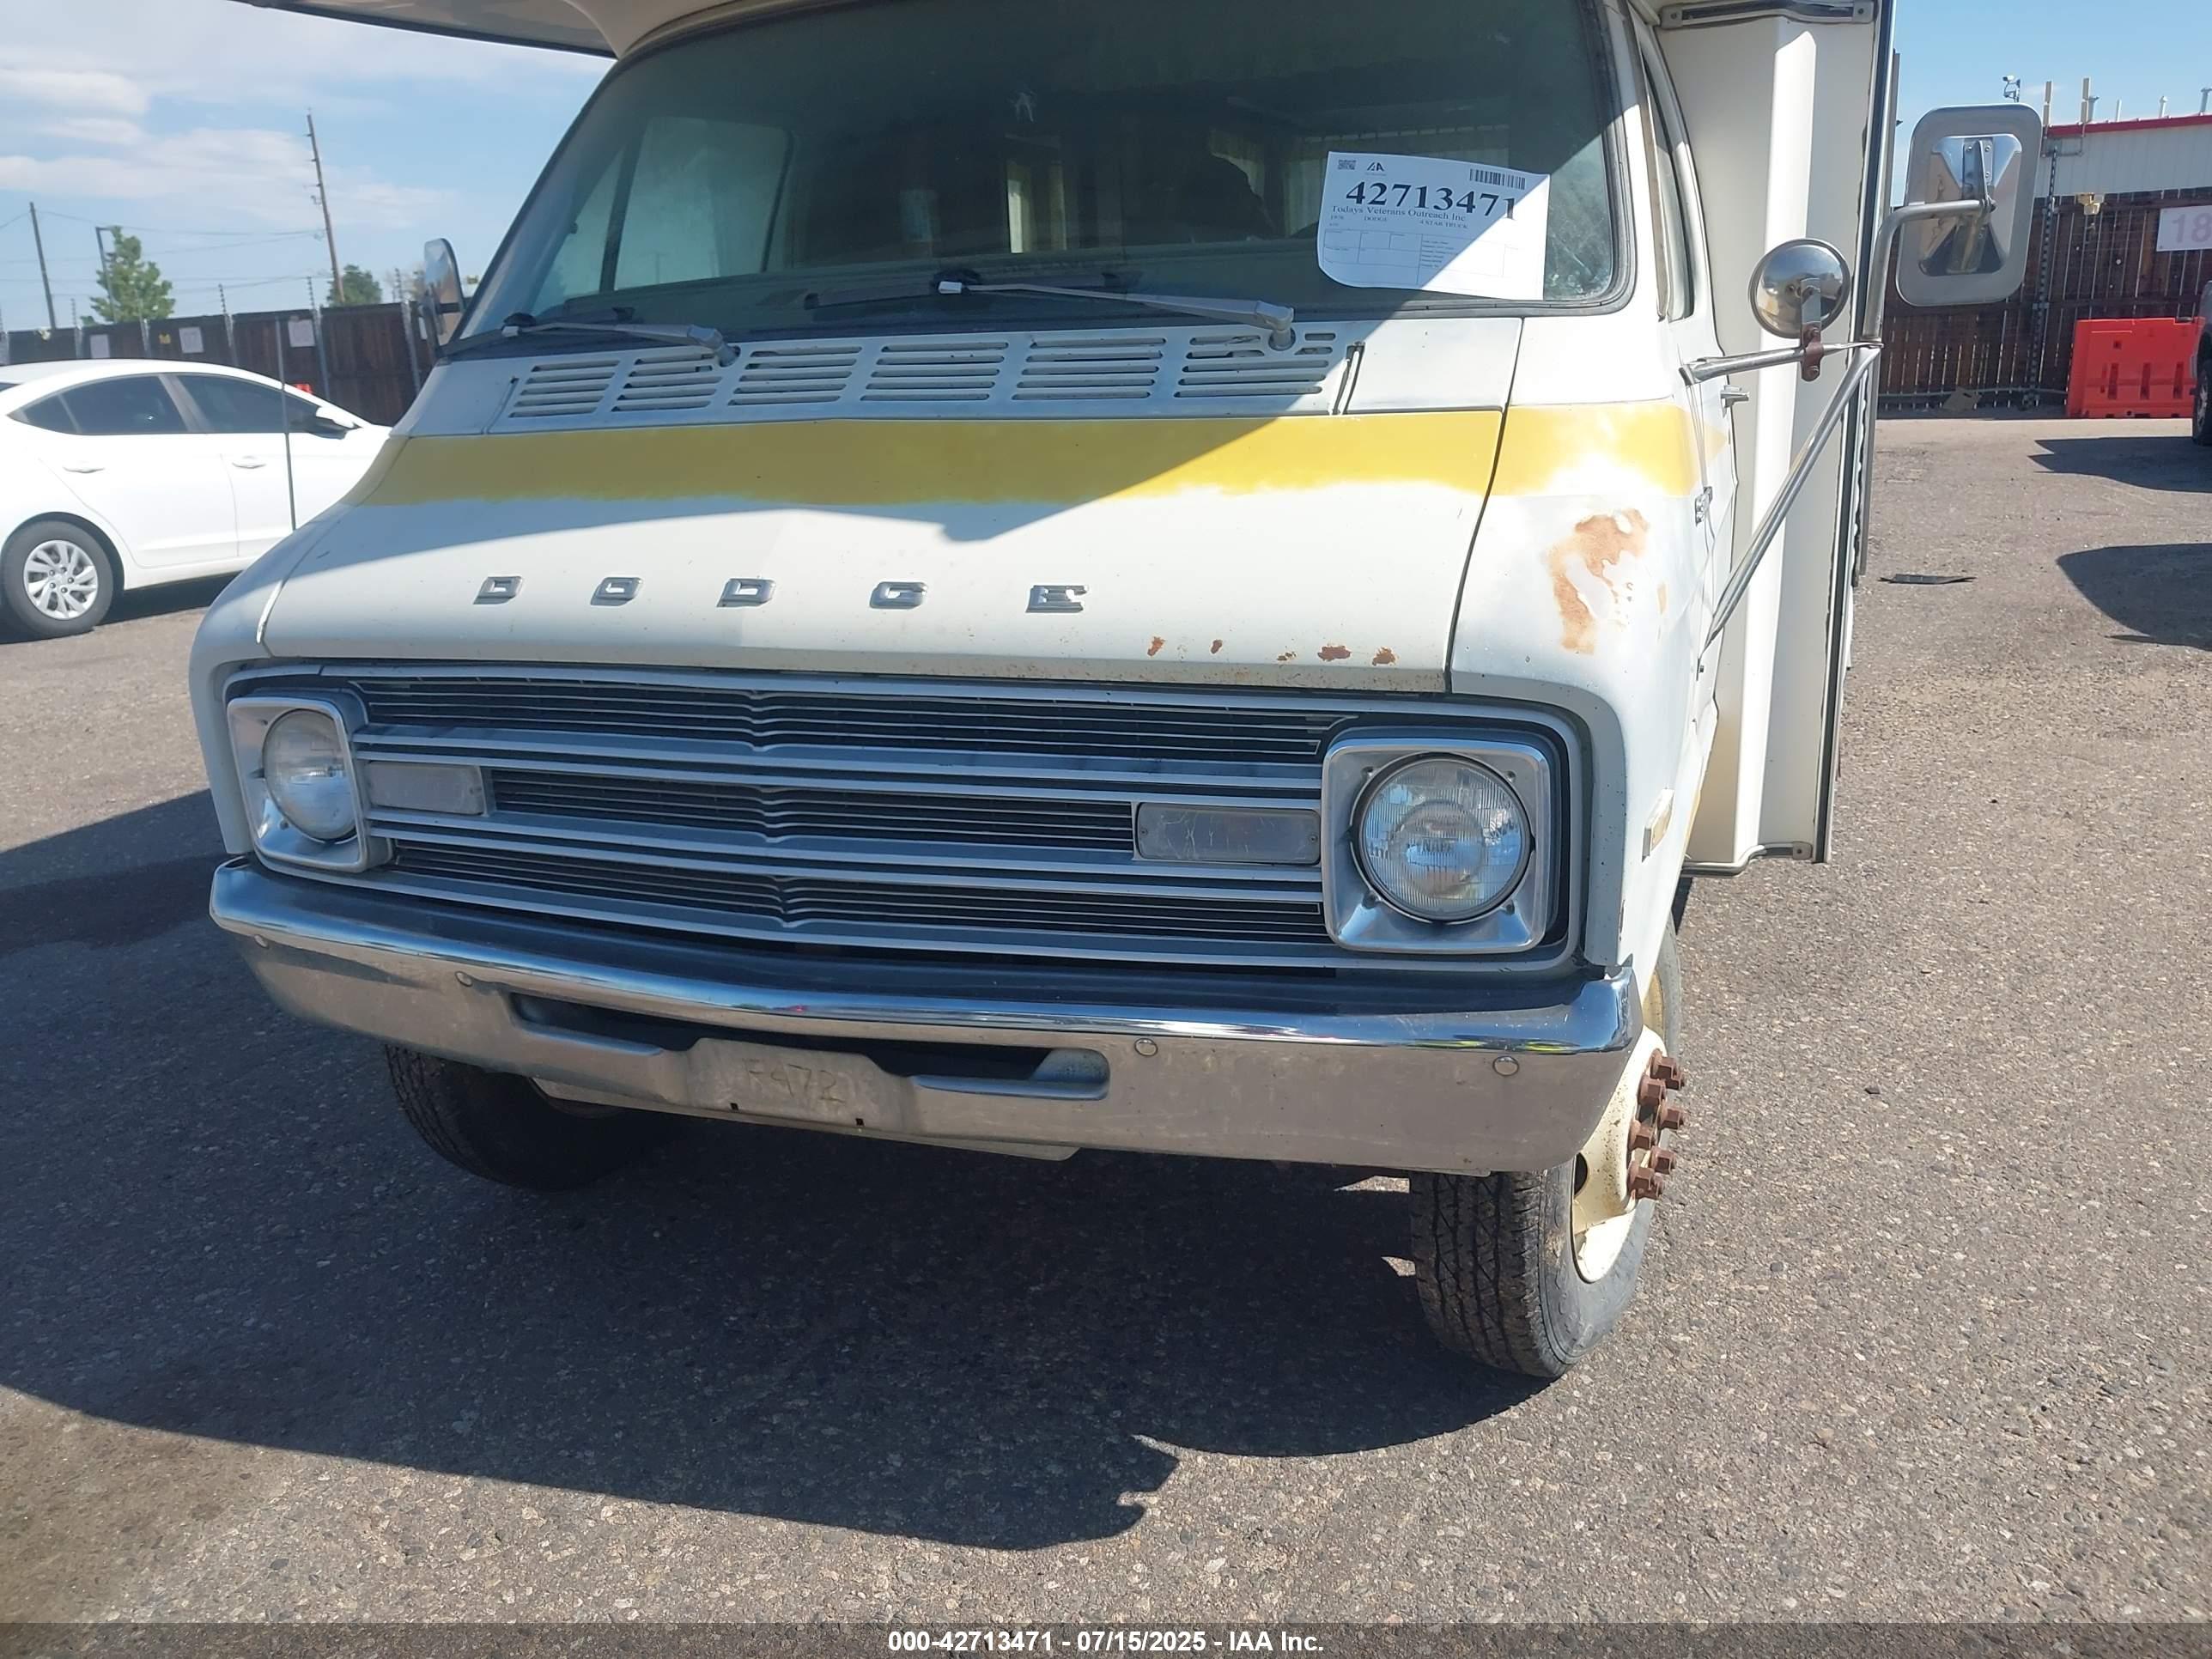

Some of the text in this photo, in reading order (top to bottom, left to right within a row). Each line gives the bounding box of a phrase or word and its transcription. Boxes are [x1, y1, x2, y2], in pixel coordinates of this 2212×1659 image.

[1332, 205, 1466, 222] Todays Veterans Outreach Inc
[1346, 181, 1516, 220] 42713471
[473, 574, 1089, 614] DODGE
